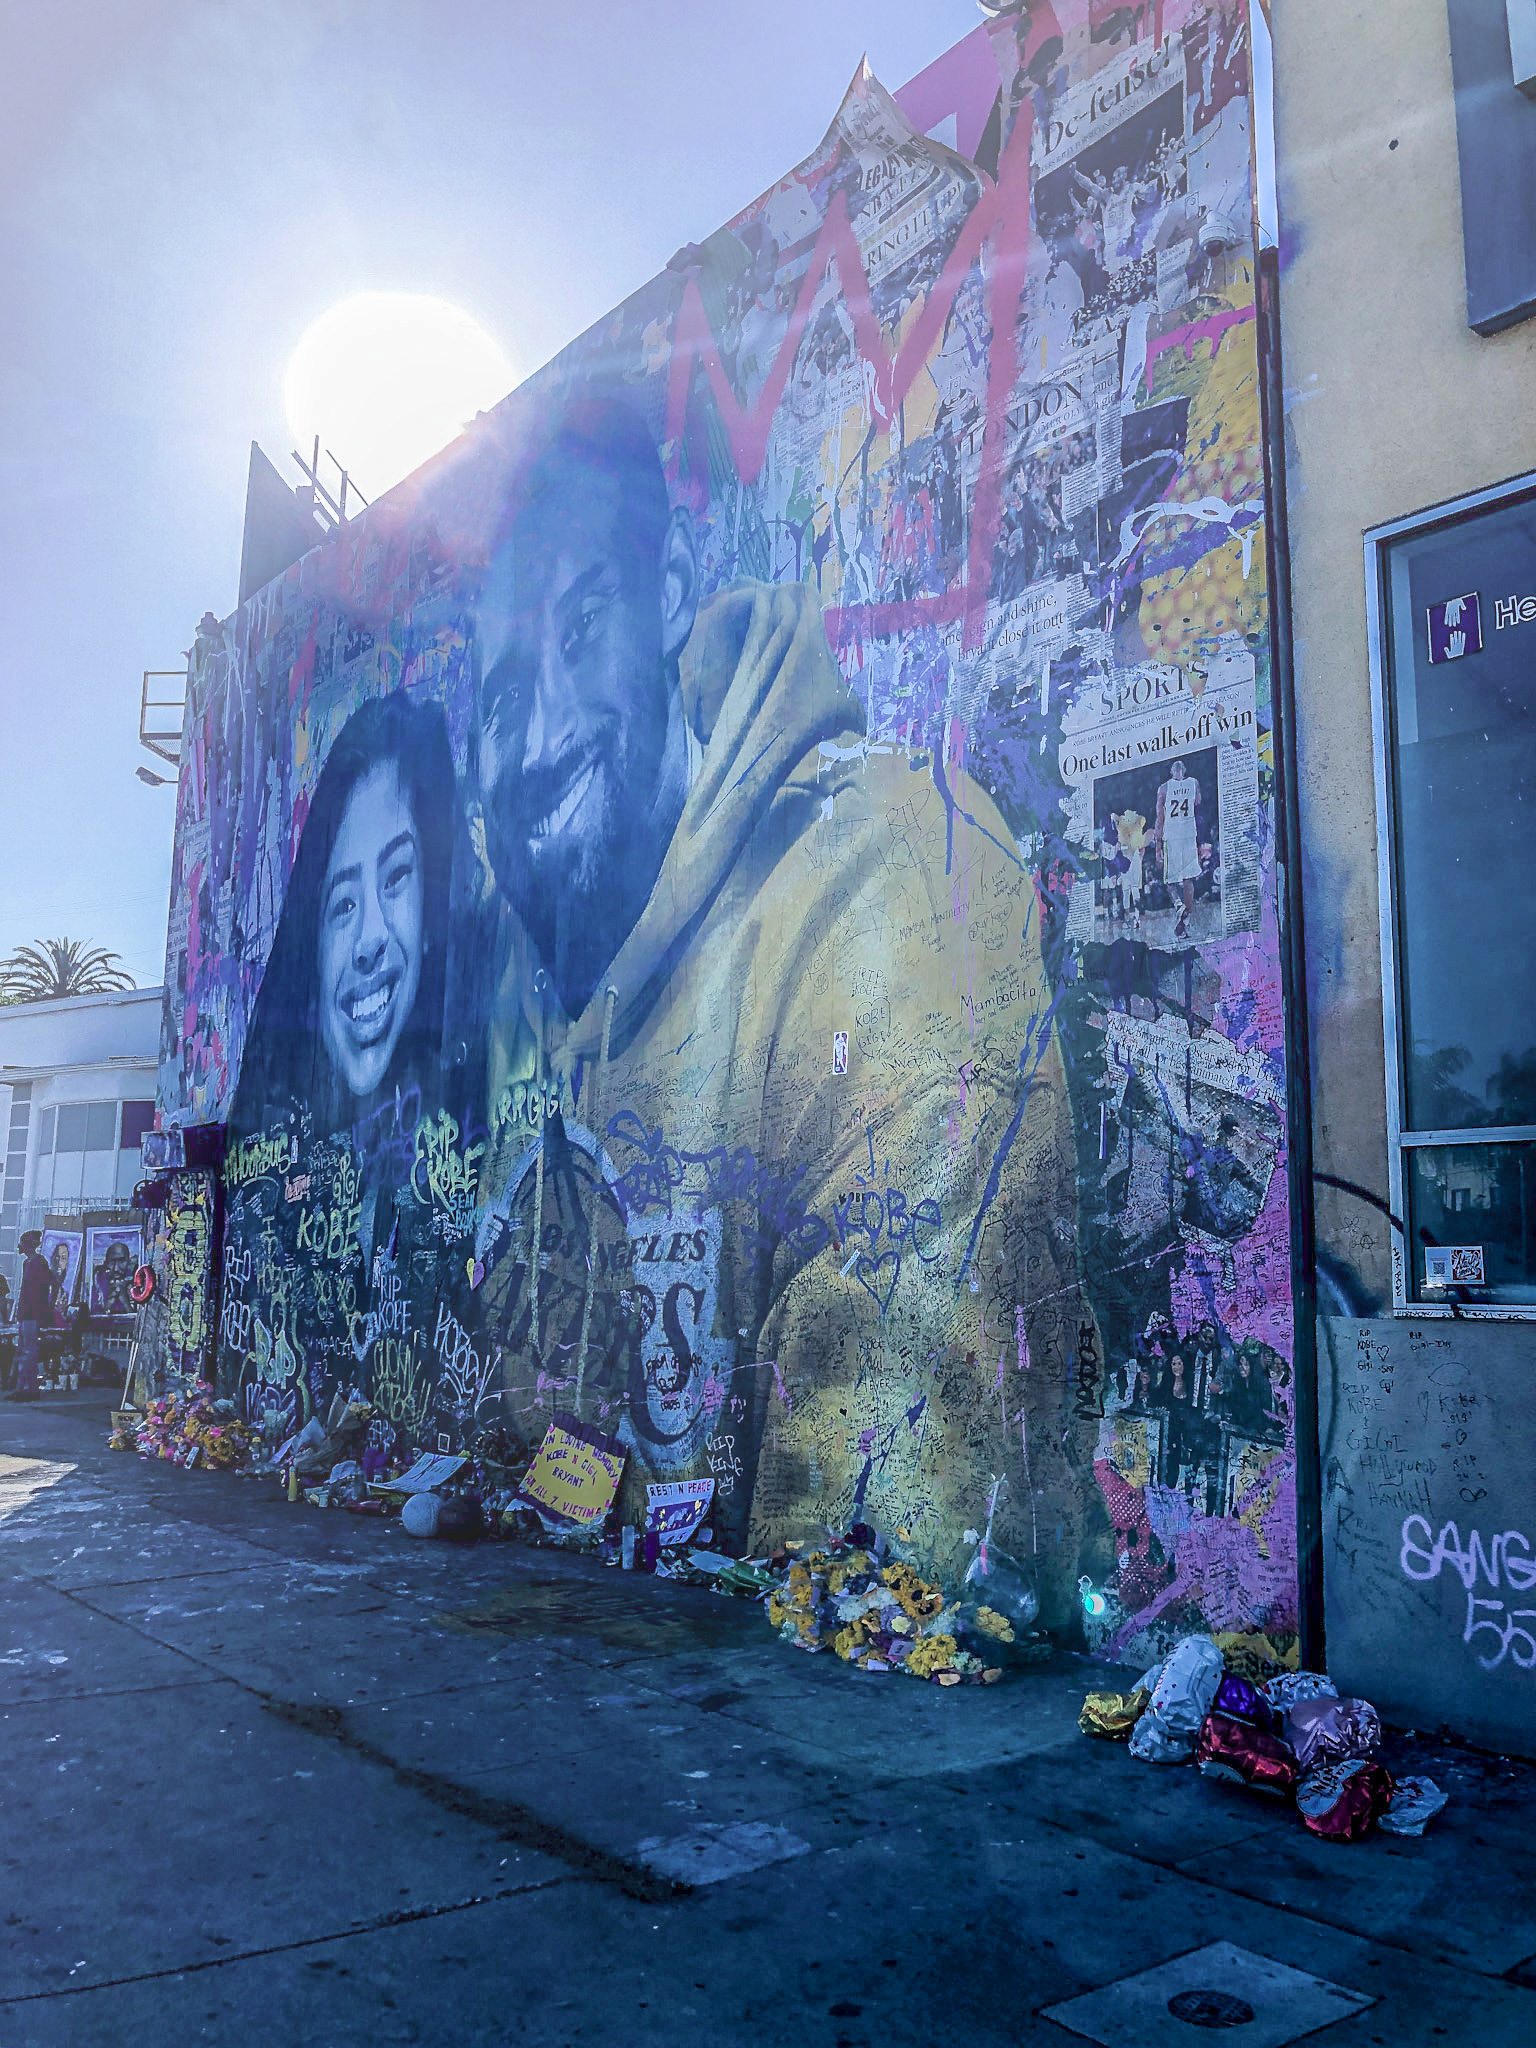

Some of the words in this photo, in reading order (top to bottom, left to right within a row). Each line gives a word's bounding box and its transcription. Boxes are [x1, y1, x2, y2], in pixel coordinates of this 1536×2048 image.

[867, 225, 910, 267] RING
[912, 207, 930, 234] IT
[997, 604, 1018, 627] and
[1020, 594, 1057, 617] shine,
[1495, 594, 1536, 630] He
[998, 625, 1029, 648] close
[1031, 618, 1041, 636] it
[1043, 611, 1065, 630] out
[1062, 753, 1099, 777] One
[1101, 742, 1133, 767] last
[1136, 711, 1214, 757] walk-off
[1217, 707, 1252, 734] win
[1170, 798, 1189, 818] 24
[960, 980, 1036, 1017] Mambacita
[855, 1007, 887, 1028] KOBE
[296, 1201, 362, 1259] KOBE
[380, 1274, 402, 1301] RIP
[1357, 1339, 1377, 1350] KOBE
[1359, 1329, 1372, 1337] RIP
[544, 1436, 555, 1447] IN
[559, 1433, 587, 1452] LOVING
[592, 1445, 619, 1481] MEMORY
[546, 1448, 568, 1463] KOBE
[705, 1454, 745, 1478] KING
[551, 1466, 585, 1489] BRYANT
[650, 1483, 674, 1498] REST
[677, 1483, 685, 1495] N
[687, 1480, 713, 1494] PEACE
[533, 1483, 549, 1500] ALL
[549, 1495, 560, 1506] 7
